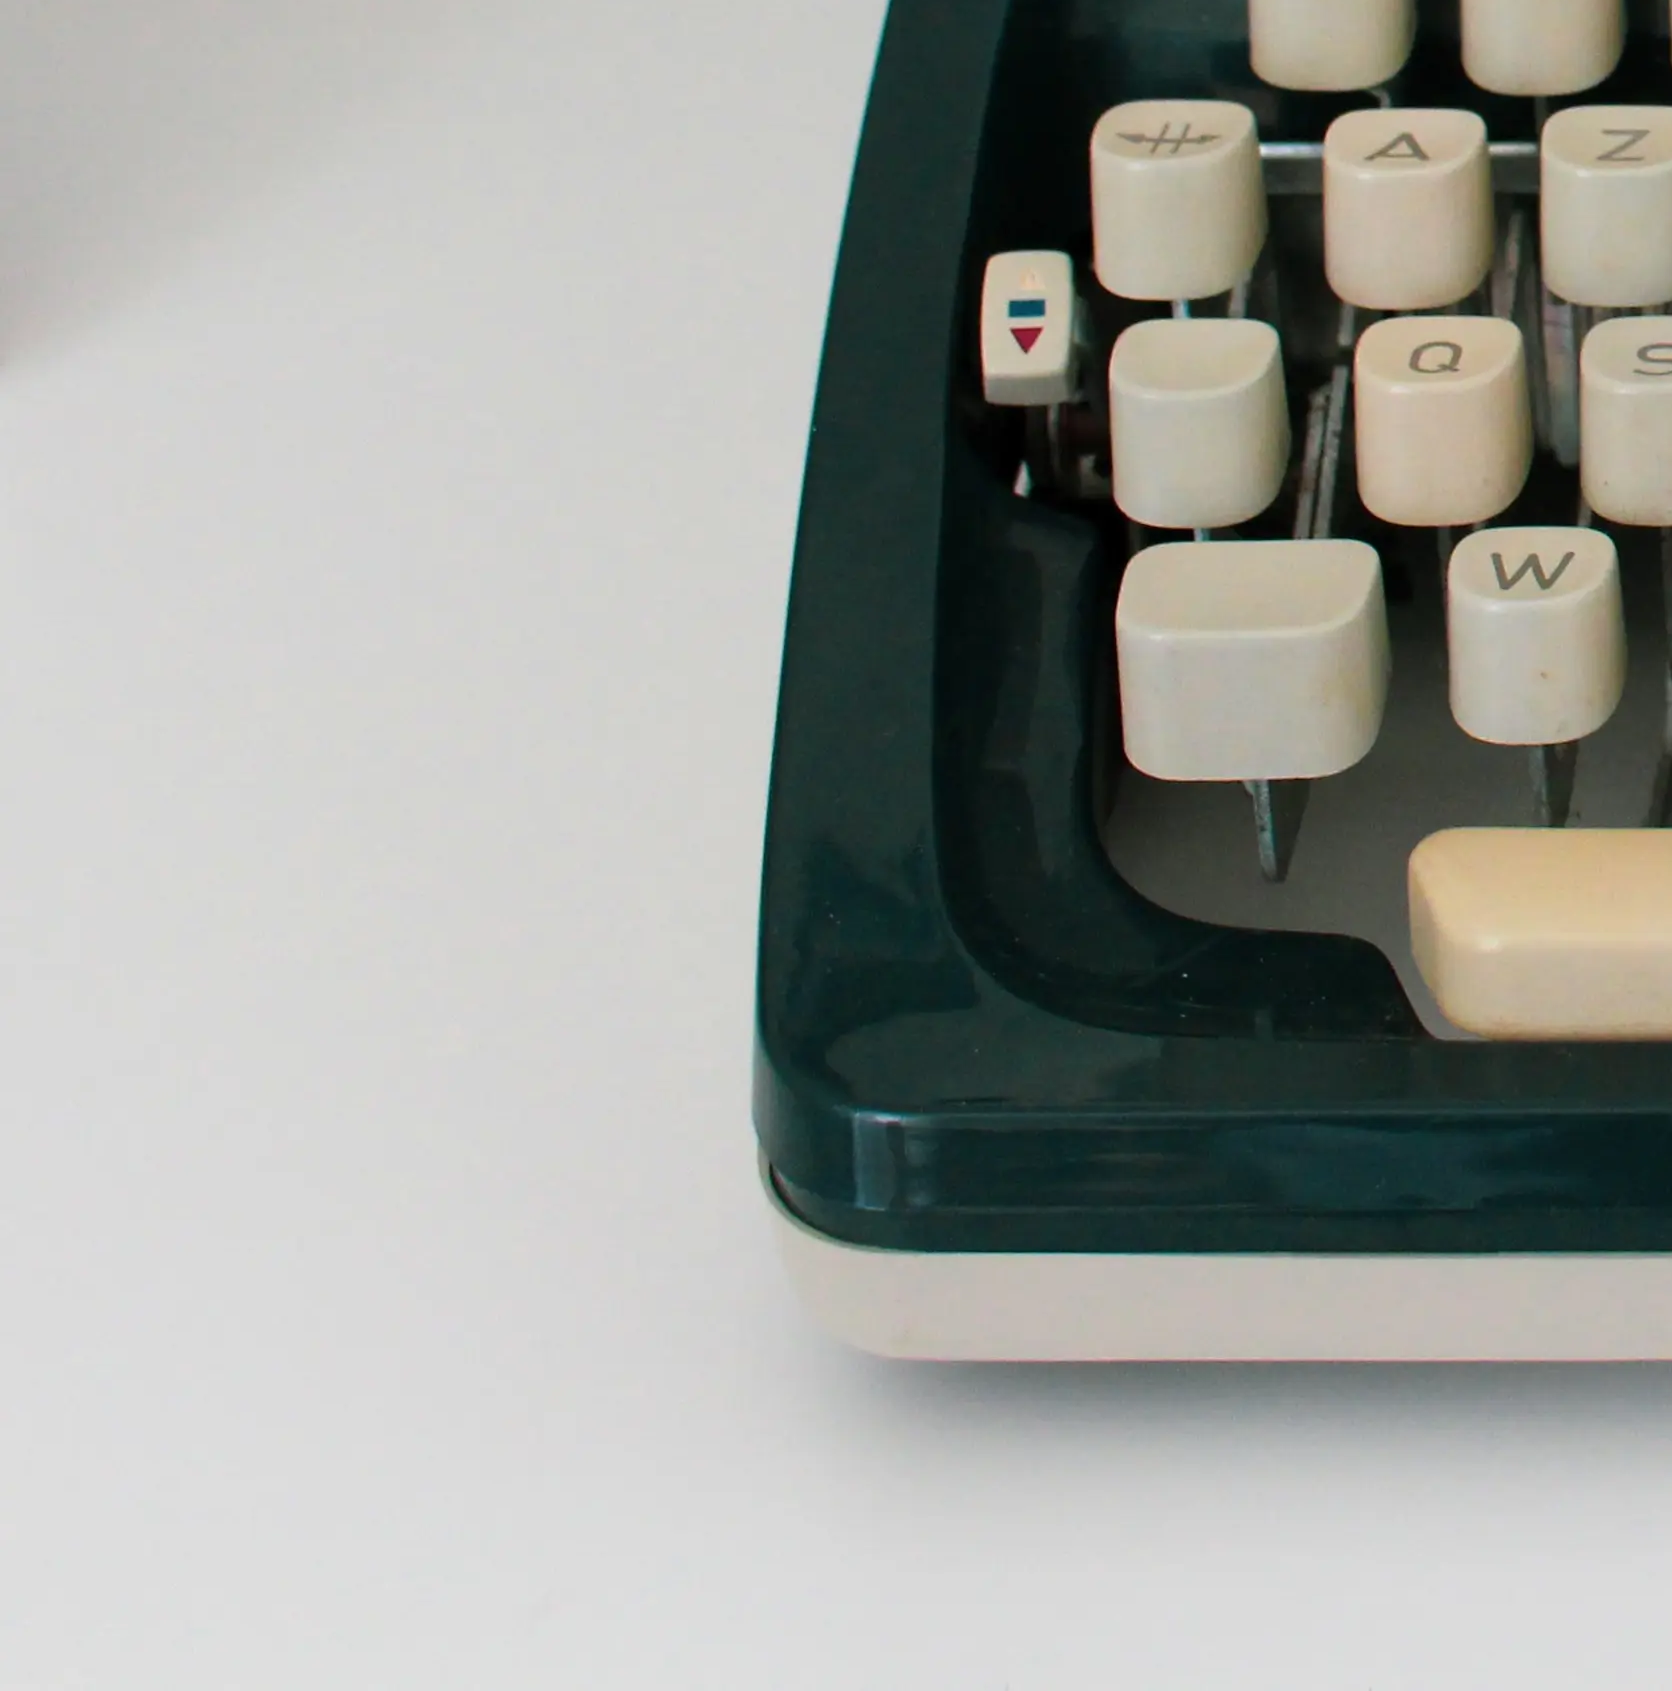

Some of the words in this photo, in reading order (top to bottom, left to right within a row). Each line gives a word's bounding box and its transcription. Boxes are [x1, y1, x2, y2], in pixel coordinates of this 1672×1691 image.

[1364, 132, 1430, 161] A
[1596, 129, 1650, 162] Z
[1409, 341, 1462, 374] Q
[1491, 552, 1572, 590] W
